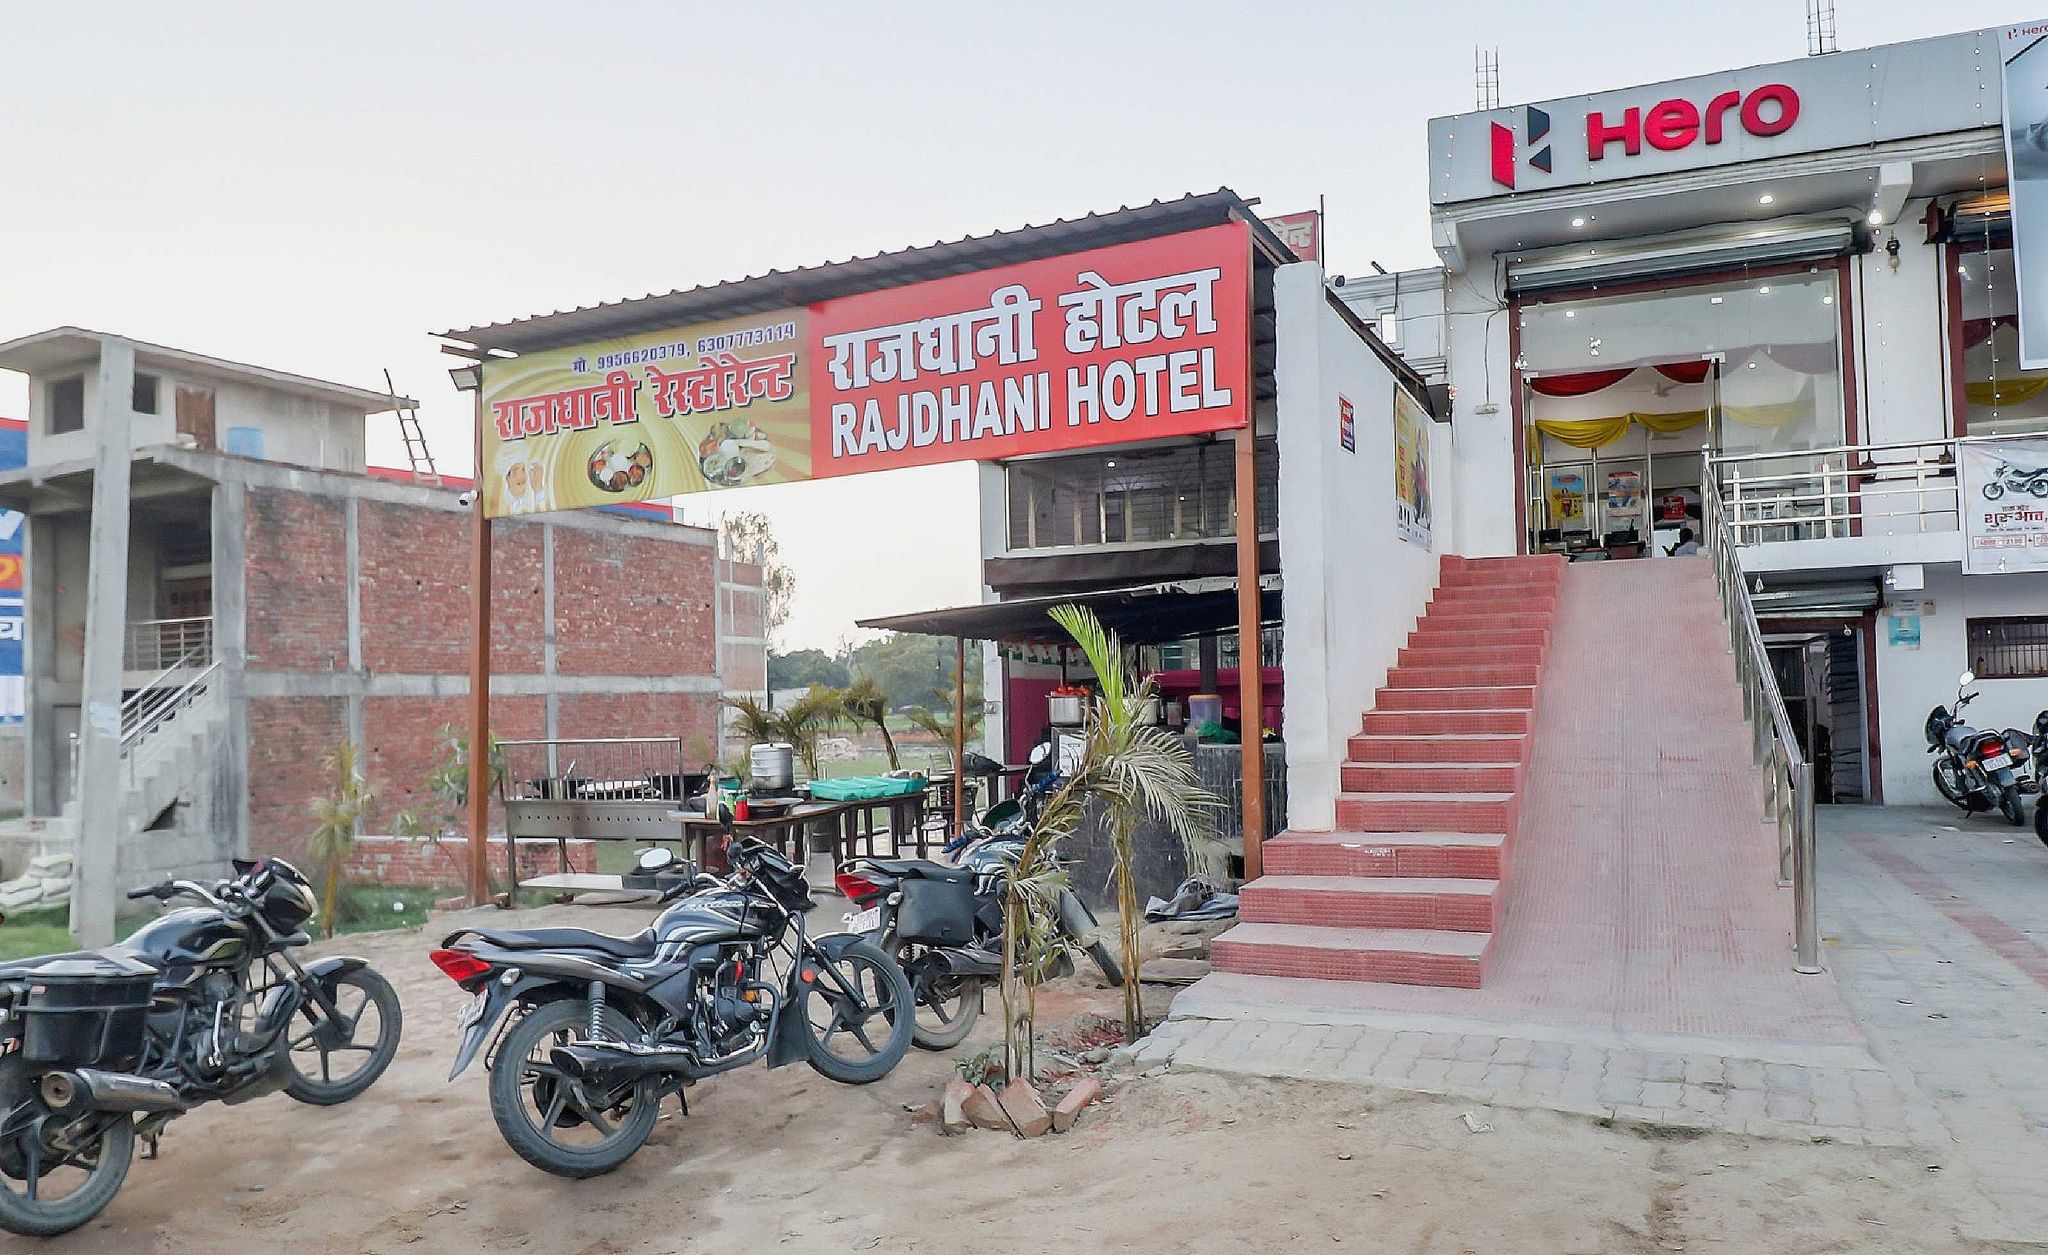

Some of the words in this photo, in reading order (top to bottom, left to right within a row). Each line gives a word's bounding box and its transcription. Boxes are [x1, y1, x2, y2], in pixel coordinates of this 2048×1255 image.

[1586, 82, 1801, 162] Hero
[597, 343, 691, 371] 9956620379,
[697, 323, 794, 353] 6307773114
[823, 284, 1041, 391] राजधानी
[1058, 267, 1220, 354] होटल
[491, 369, 640, 441] राजधानी
[644, 353, 797, 418] रेस्टोरेन्ट
[831, 371, 1050, 458] RAJDHANI
[1067, 347, 1231, 426] HOTEL
